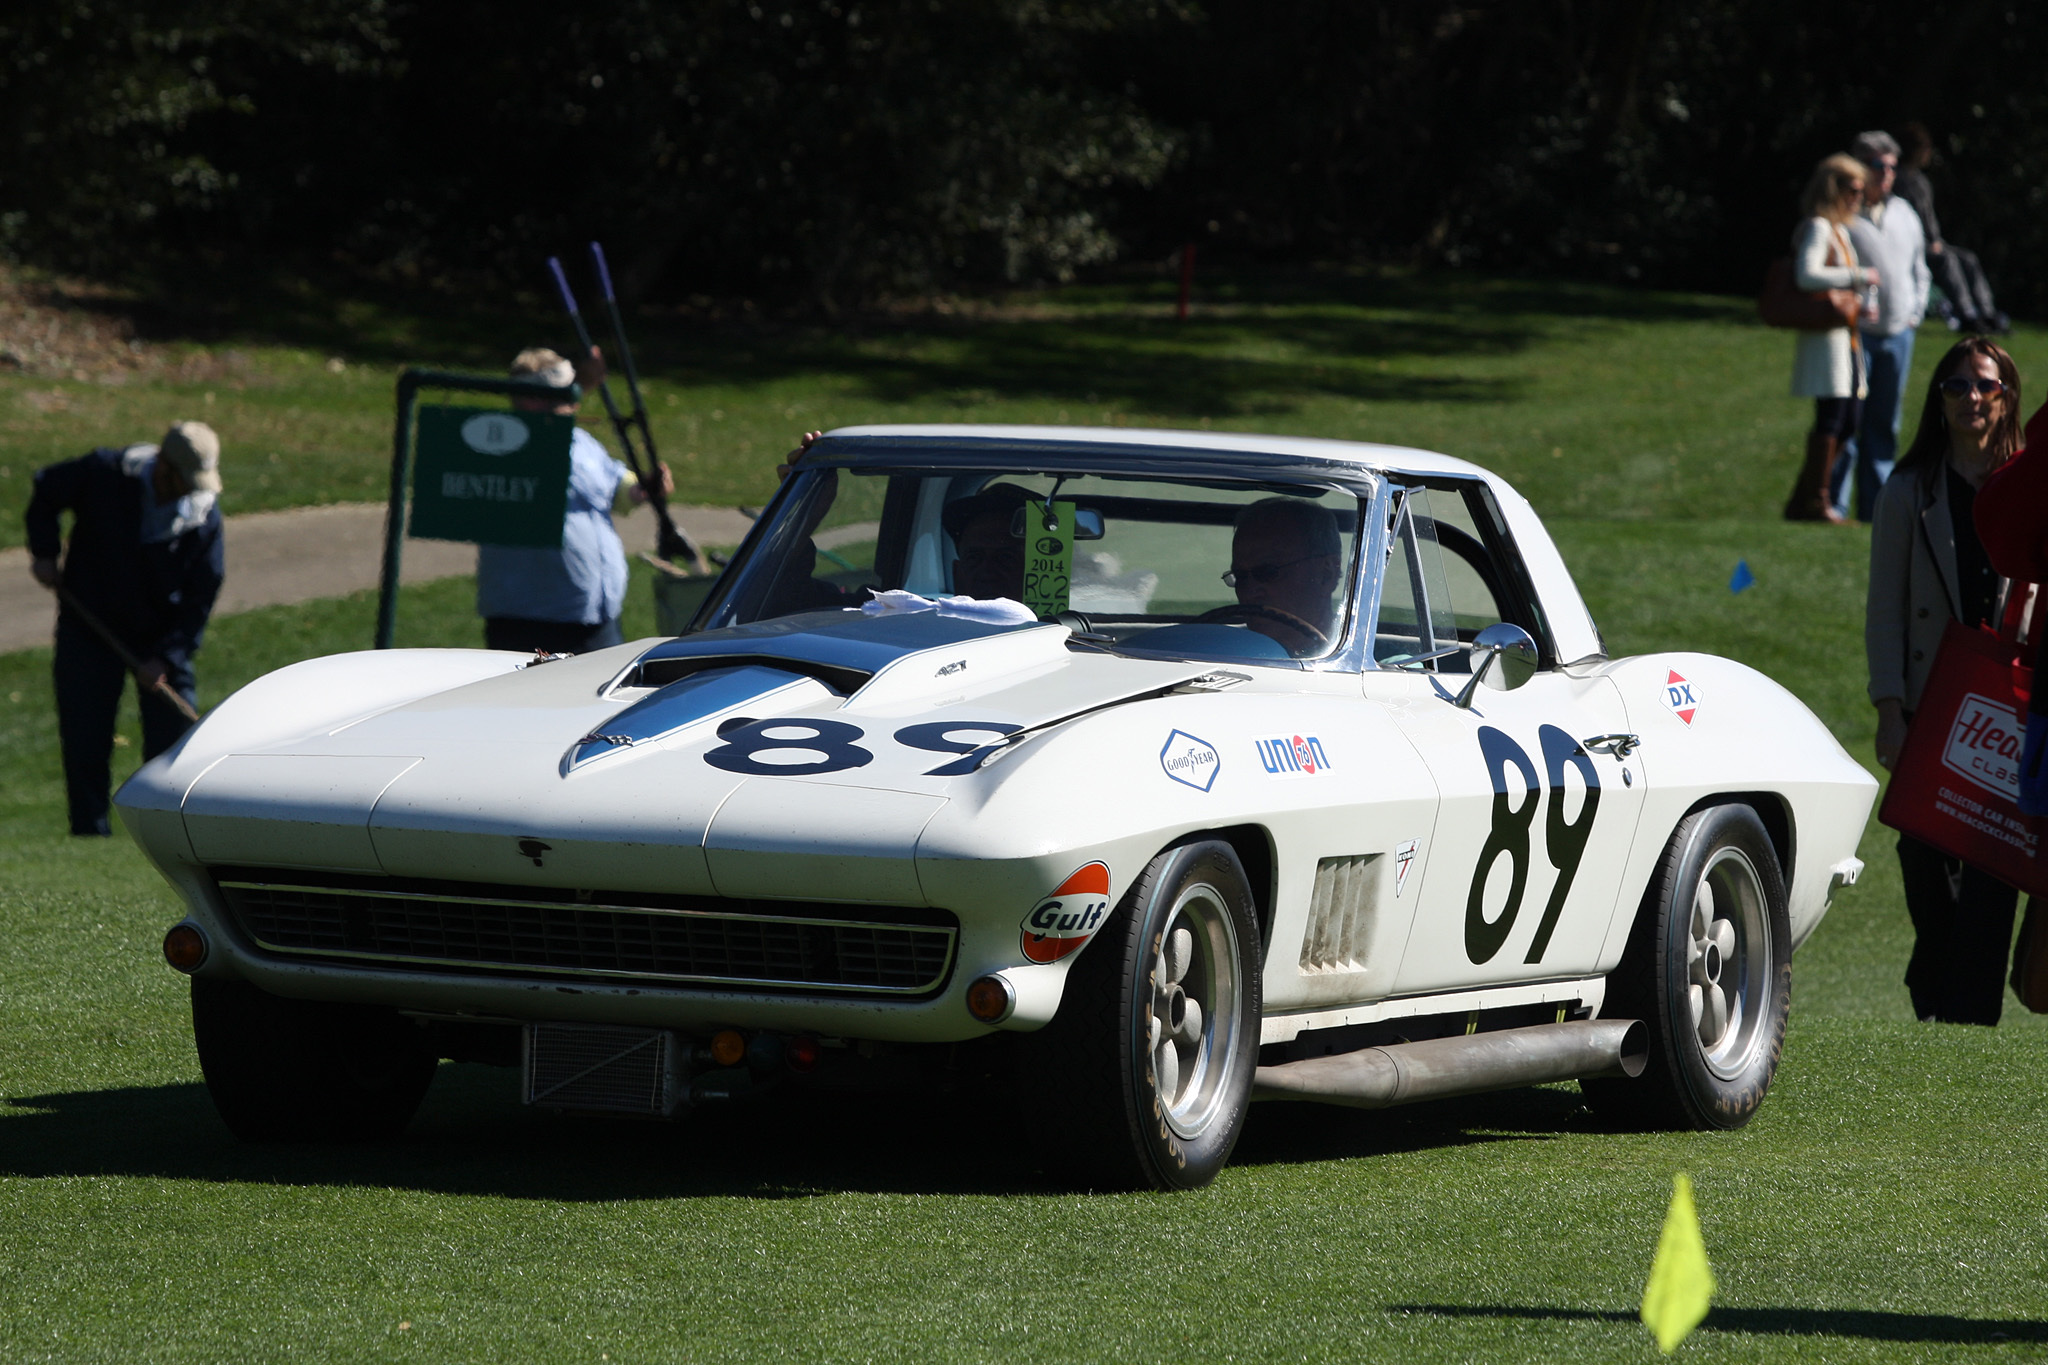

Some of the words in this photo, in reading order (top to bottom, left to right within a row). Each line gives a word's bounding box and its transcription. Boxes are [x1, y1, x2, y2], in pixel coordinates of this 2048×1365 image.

[442, 472, 539, 502] BENTLEY
[1031, 559, 1064, 572] 2014
[1025, 573, 1068, 599] RC2
[934, 660, 967, 677] 427
[1667, 684, 1696, 707] DX
[703, 717, 1025, 776] 89
[1297, 742, 1312, 767] 76
[1938, 786, 1984, 815] COLLECTOR
[1984, 808, 2003, 825] CAR
[1464, 724, 1602, 966] 89
[1030, 901, 1106, 931] Gulf
